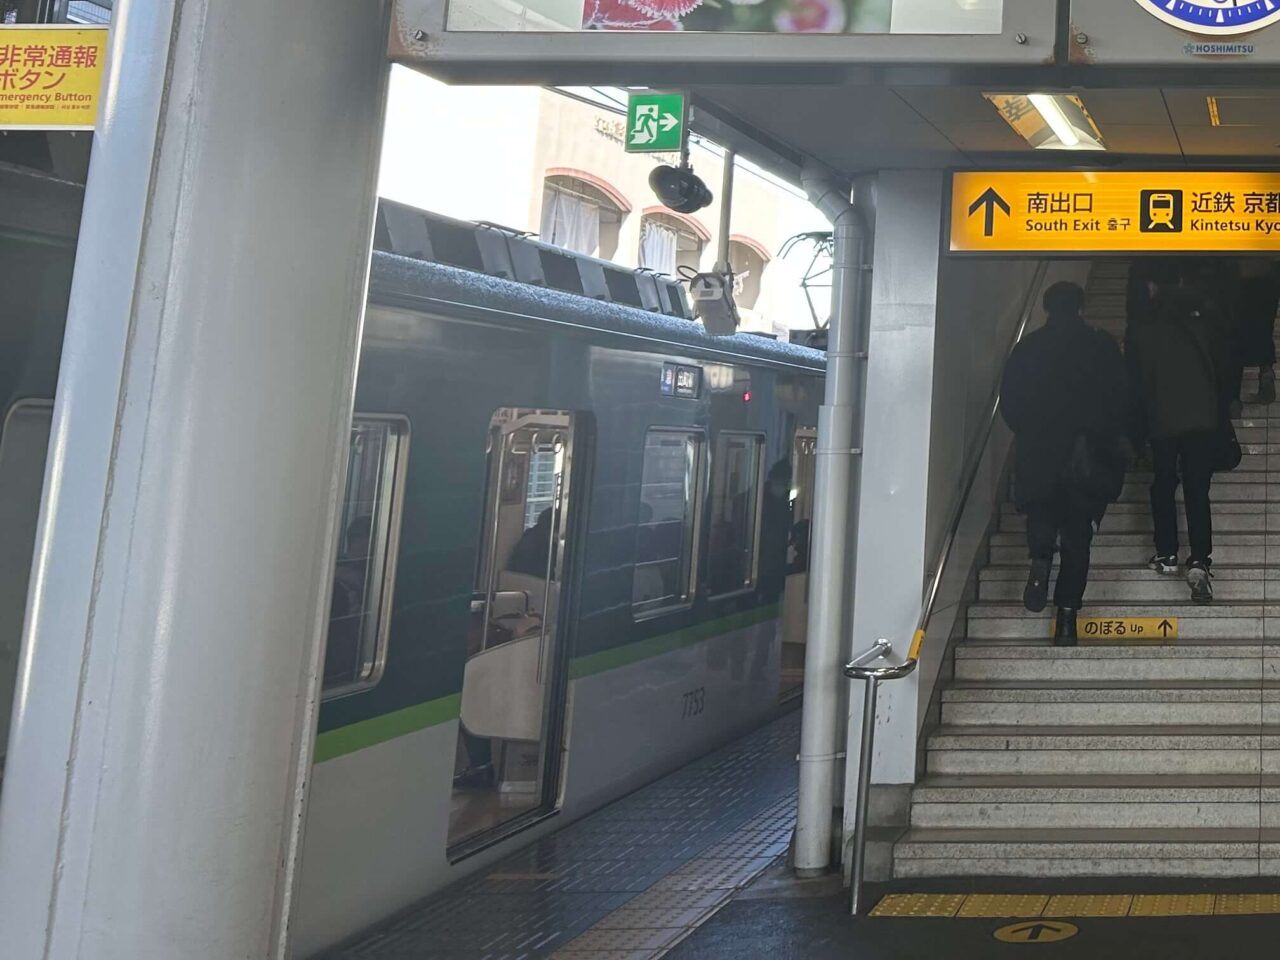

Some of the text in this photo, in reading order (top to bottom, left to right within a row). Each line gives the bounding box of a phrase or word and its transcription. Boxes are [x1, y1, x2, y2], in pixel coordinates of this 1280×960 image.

[1196, 44, 1254, 53] HOSHIMITSU
[0, 44, 98, 68] 非常通報
[0, 68, 66, 91] ボタン
[0, 92, 92, 104] mergency Button
[1027, 192, 1093, 214] 南出口
[1191, 191, 1236, 214] 近鉄
[1026, 219, 1101, 232] South Exit
[1190, 219, 1250, 232] Kintetsu
[1084, 621, 1144, 635] のぼる Up
